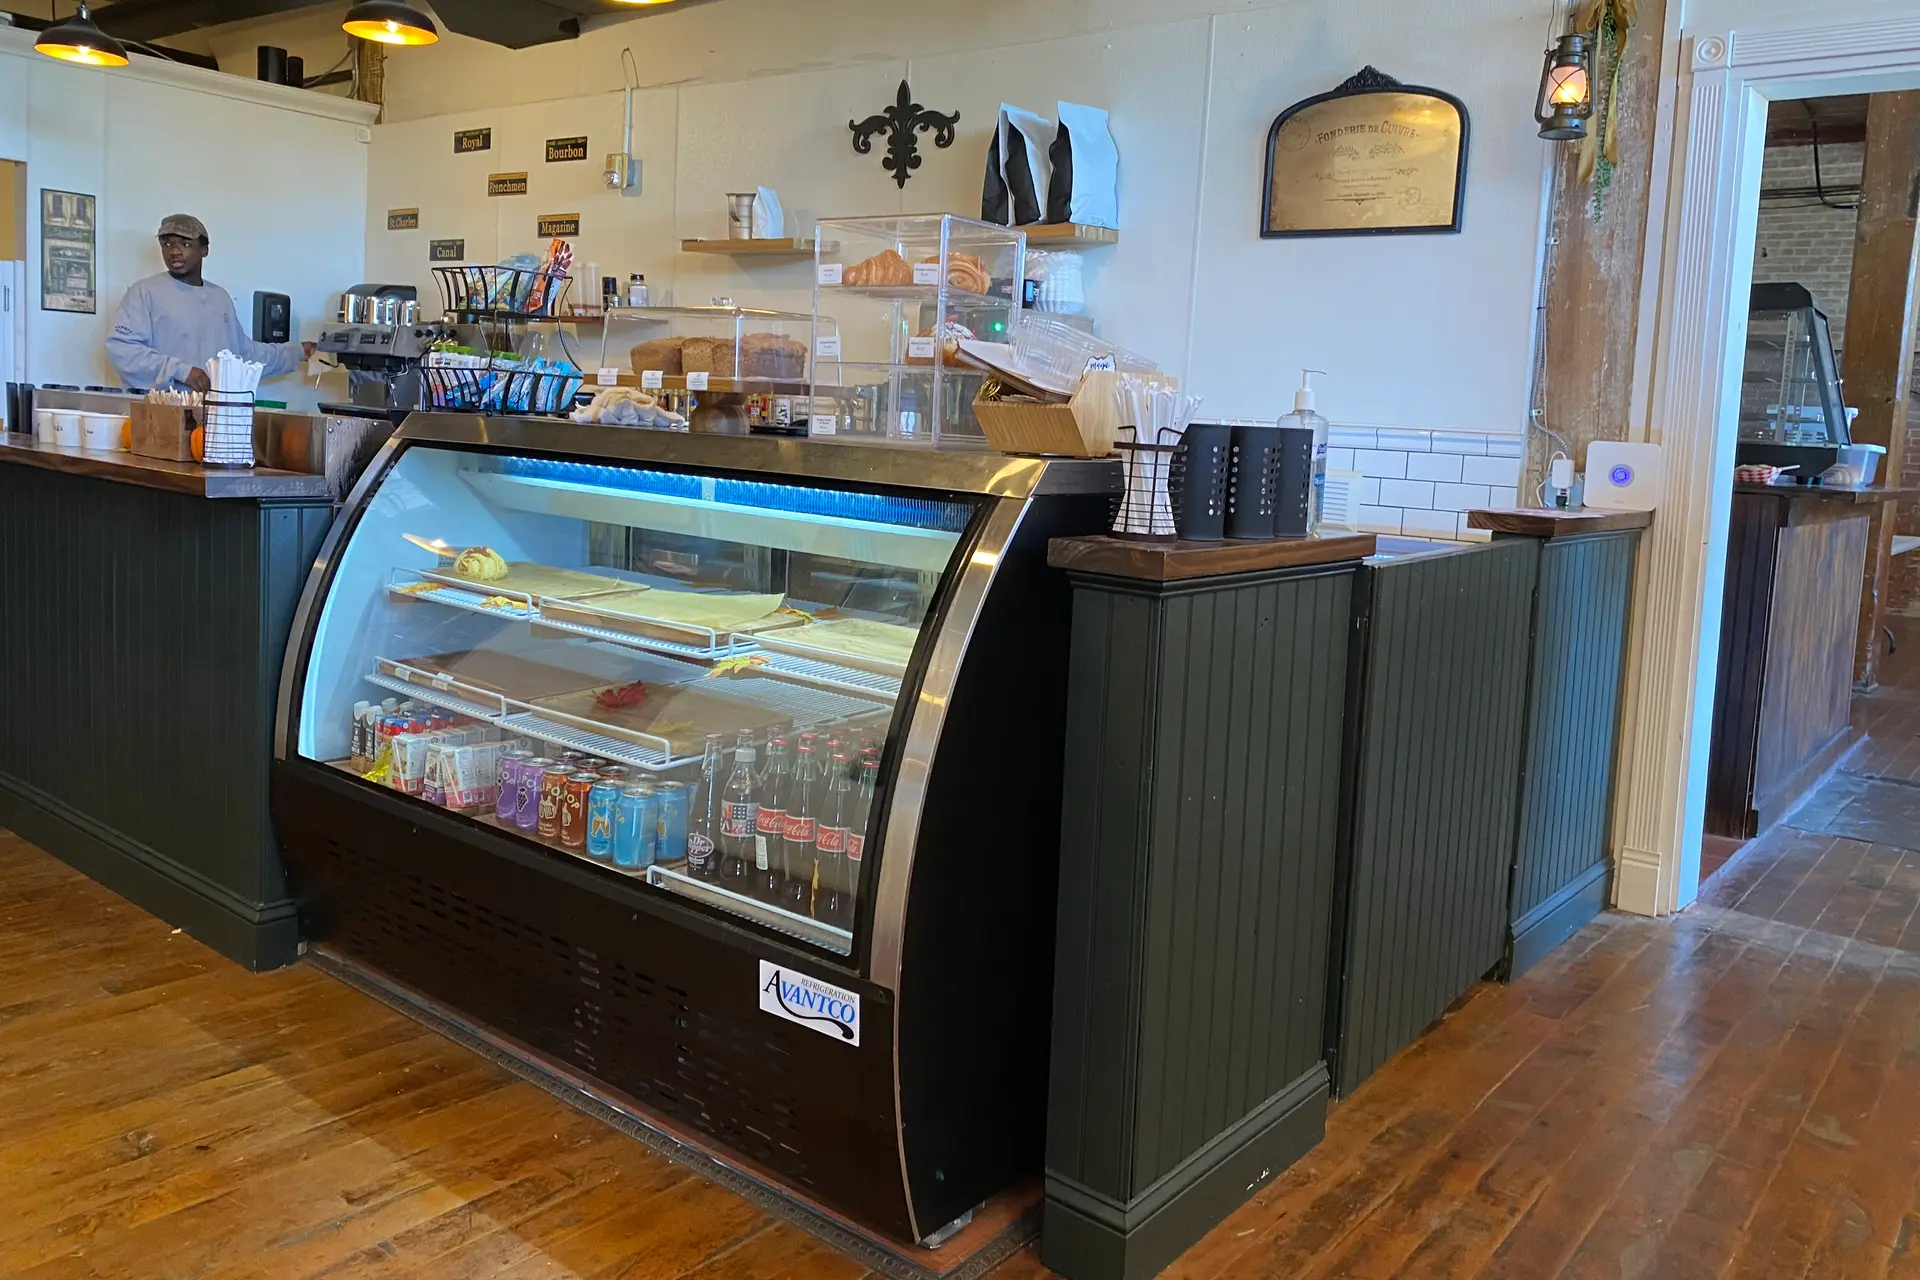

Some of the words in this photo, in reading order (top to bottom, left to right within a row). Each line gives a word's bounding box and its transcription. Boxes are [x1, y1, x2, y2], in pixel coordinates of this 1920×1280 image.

[1317, 124, 1365, 144] FONDERIE
[1367, 124, 1379, 133] DE
[1381, 120, 1416, 138] CUIVRE
[462, 136, 483, 150] Royal
[548, 146, 584, 160] Bourbon
[489, 178, 526, 193] Frenchmen
[541, 221, 575, 235] Magazine
[436, 246, 457, 258] Canal
[693, 836, 705, 846] Dr
[762, 969, 855, 1027] AVANTCO
[801, 978, 856, 1004] REFRIGERATION
